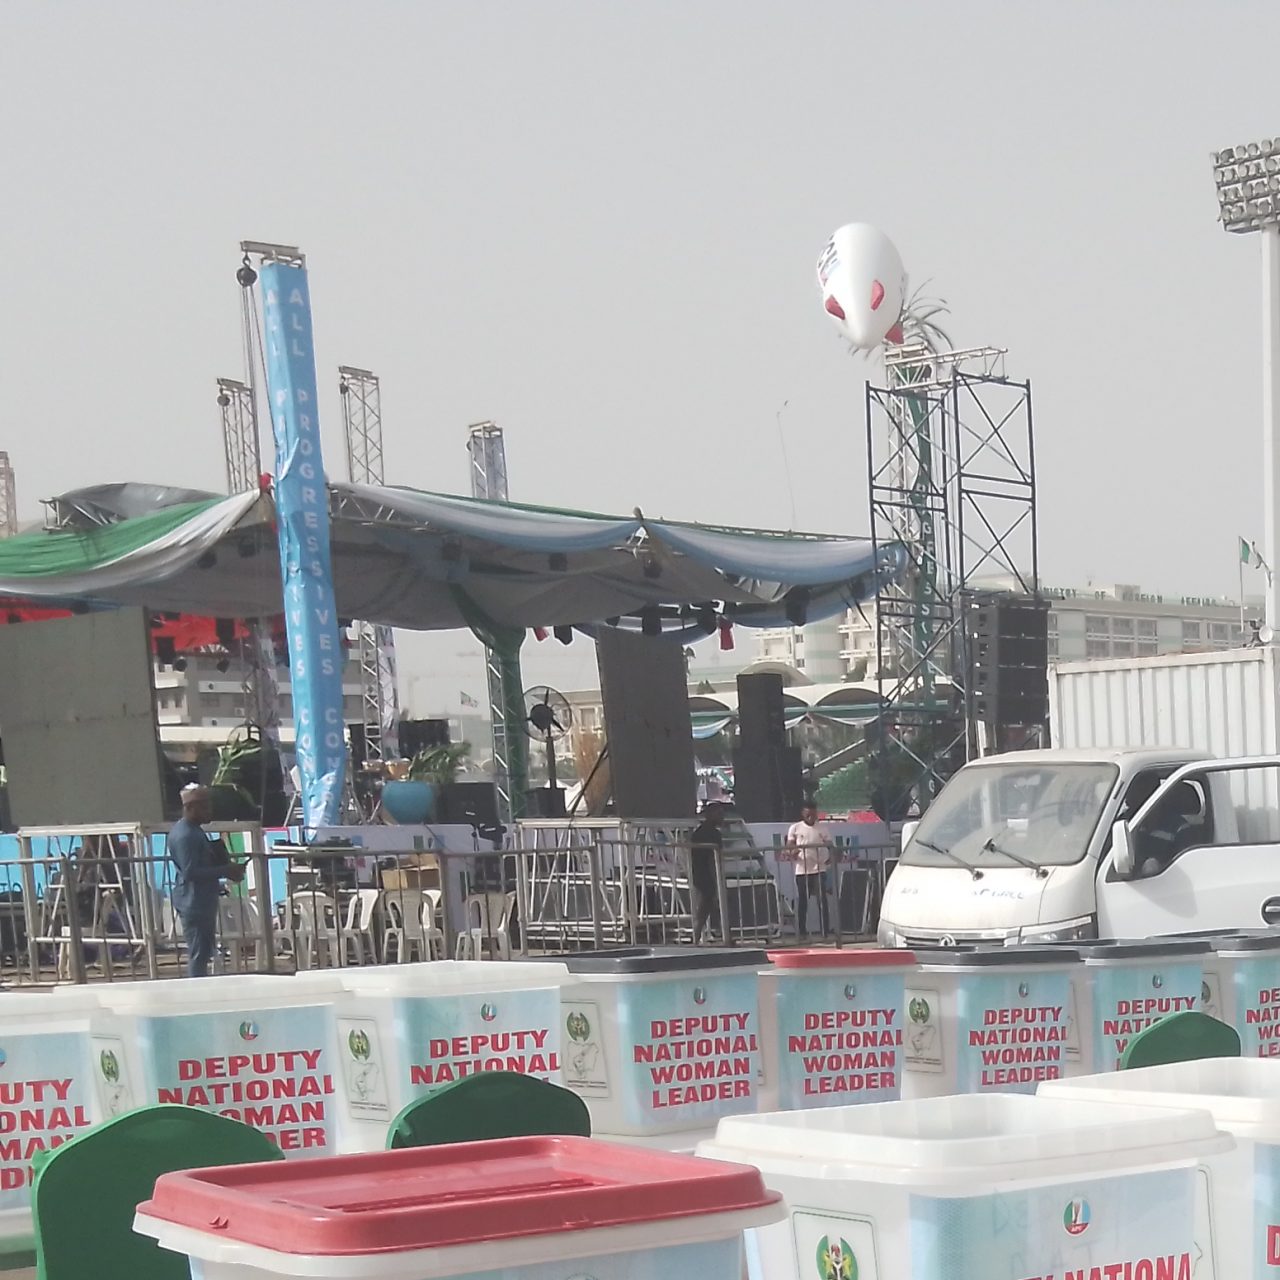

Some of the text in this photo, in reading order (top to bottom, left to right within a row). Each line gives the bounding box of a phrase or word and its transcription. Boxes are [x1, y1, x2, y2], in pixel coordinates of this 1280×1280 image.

[289, 288, 304, 357] ALL
[983, 1005, 1063, 1026] DEPUTY
[1116, 996, 1198, 1016] DEPUTY
[650, 1012, 751, 1040] DEPUTY
[803, 1008, 897, 1031] DEPUTY
[429, 1028, 550, 1060] DEPUTY
[788, 1029, 903, 1054] NATIONAL
[969, 1025, 1068, 1046] NATIONAL
[633, 1034, 759, 1064] NATIONAL
[803, 1050, 896, 1074] WOMAN
[981, 1044, 1061, 1066] WOMAN
[178, 1049, 323, 1082] DEPUTY
[410, 1050, 561, 1085] NATIONAL
[650, 1058, 751, 1085] WOMAN
[981, 1064, 1061, 1086] LEADER
[157, 1074, 336, 1107] NATIONAL
[652, 1080, 751, 1109] LEADER
[803, 1071, 896, 1096] LEADER
